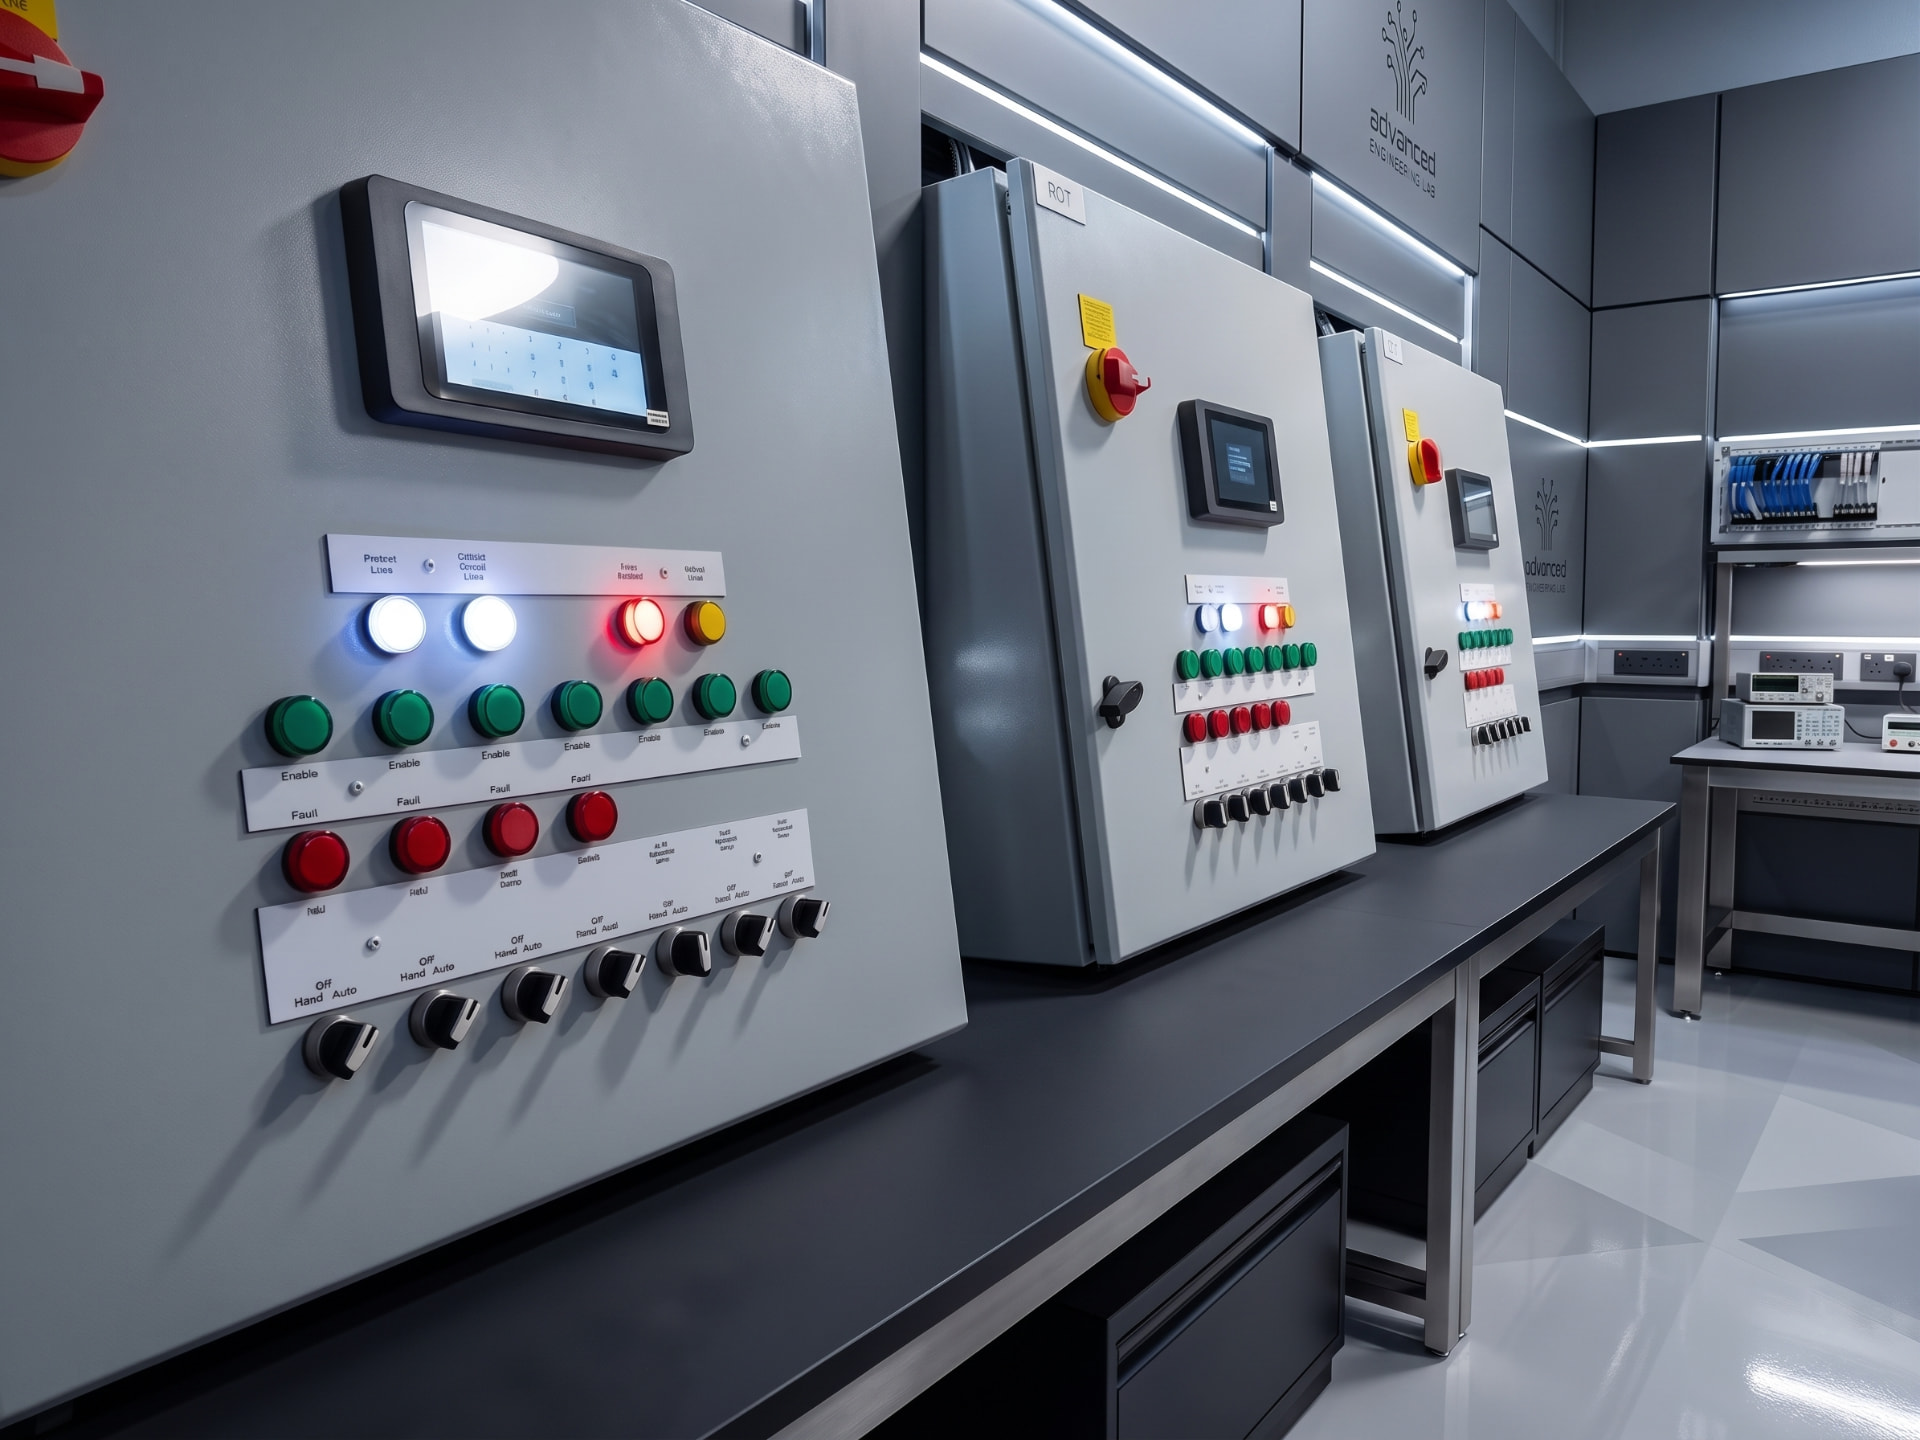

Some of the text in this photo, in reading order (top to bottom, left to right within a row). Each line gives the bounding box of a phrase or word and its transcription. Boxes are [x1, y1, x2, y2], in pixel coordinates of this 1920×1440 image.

[1370, 107, 1436, 179] advanced
[1369, 138, 1436, 199] ENGINEERING LAB
[1048, 181, 1071, 207] ROT
[1525, 555, 1567, 578] advanced
[481, 749, 511, 760] Enable
[281, 769, 319, 781] Enable
[511, 935, 524, 945] Off
[494, 942, 542, 959] Hand Auto
[419, 955, 435, 966] Off
[400, 963, 455, 982] Hand Auto
[315, 979, 332, 990] Off
[294, 987, 357, 1007] Hand Auto
